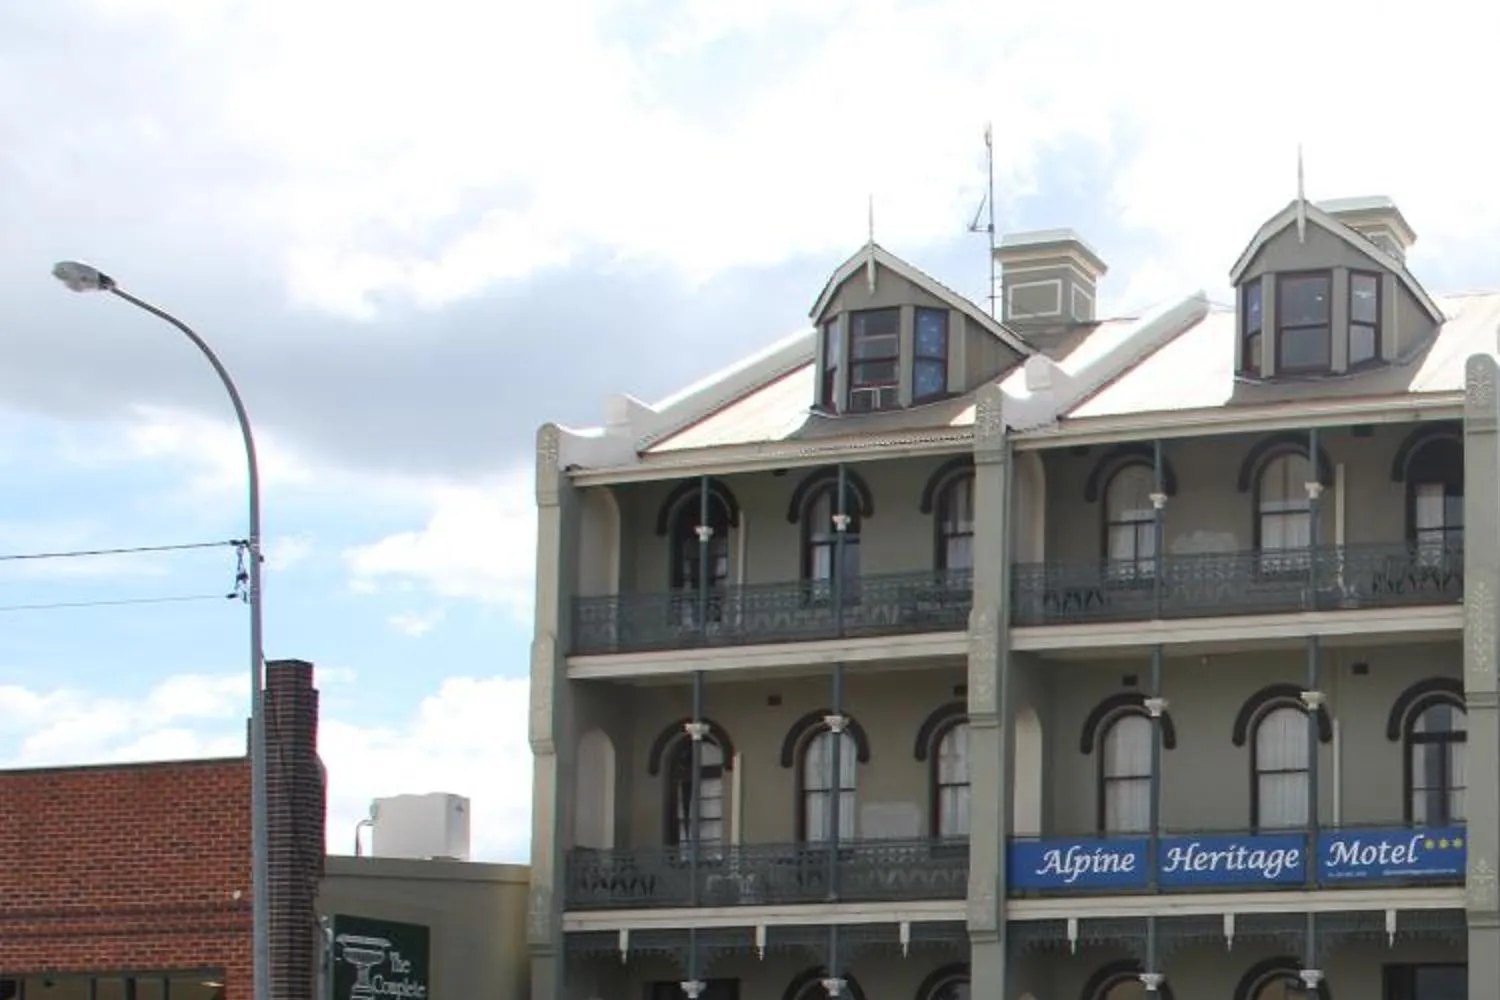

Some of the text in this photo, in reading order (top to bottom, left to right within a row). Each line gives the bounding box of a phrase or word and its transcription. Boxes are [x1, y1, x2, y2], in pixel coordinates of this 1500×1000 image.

[1035, 833, 1424, 882] Alpine Heritage Motel
[389, 951, 411, 973] The
[372, 974, 426, 1000] Complete
